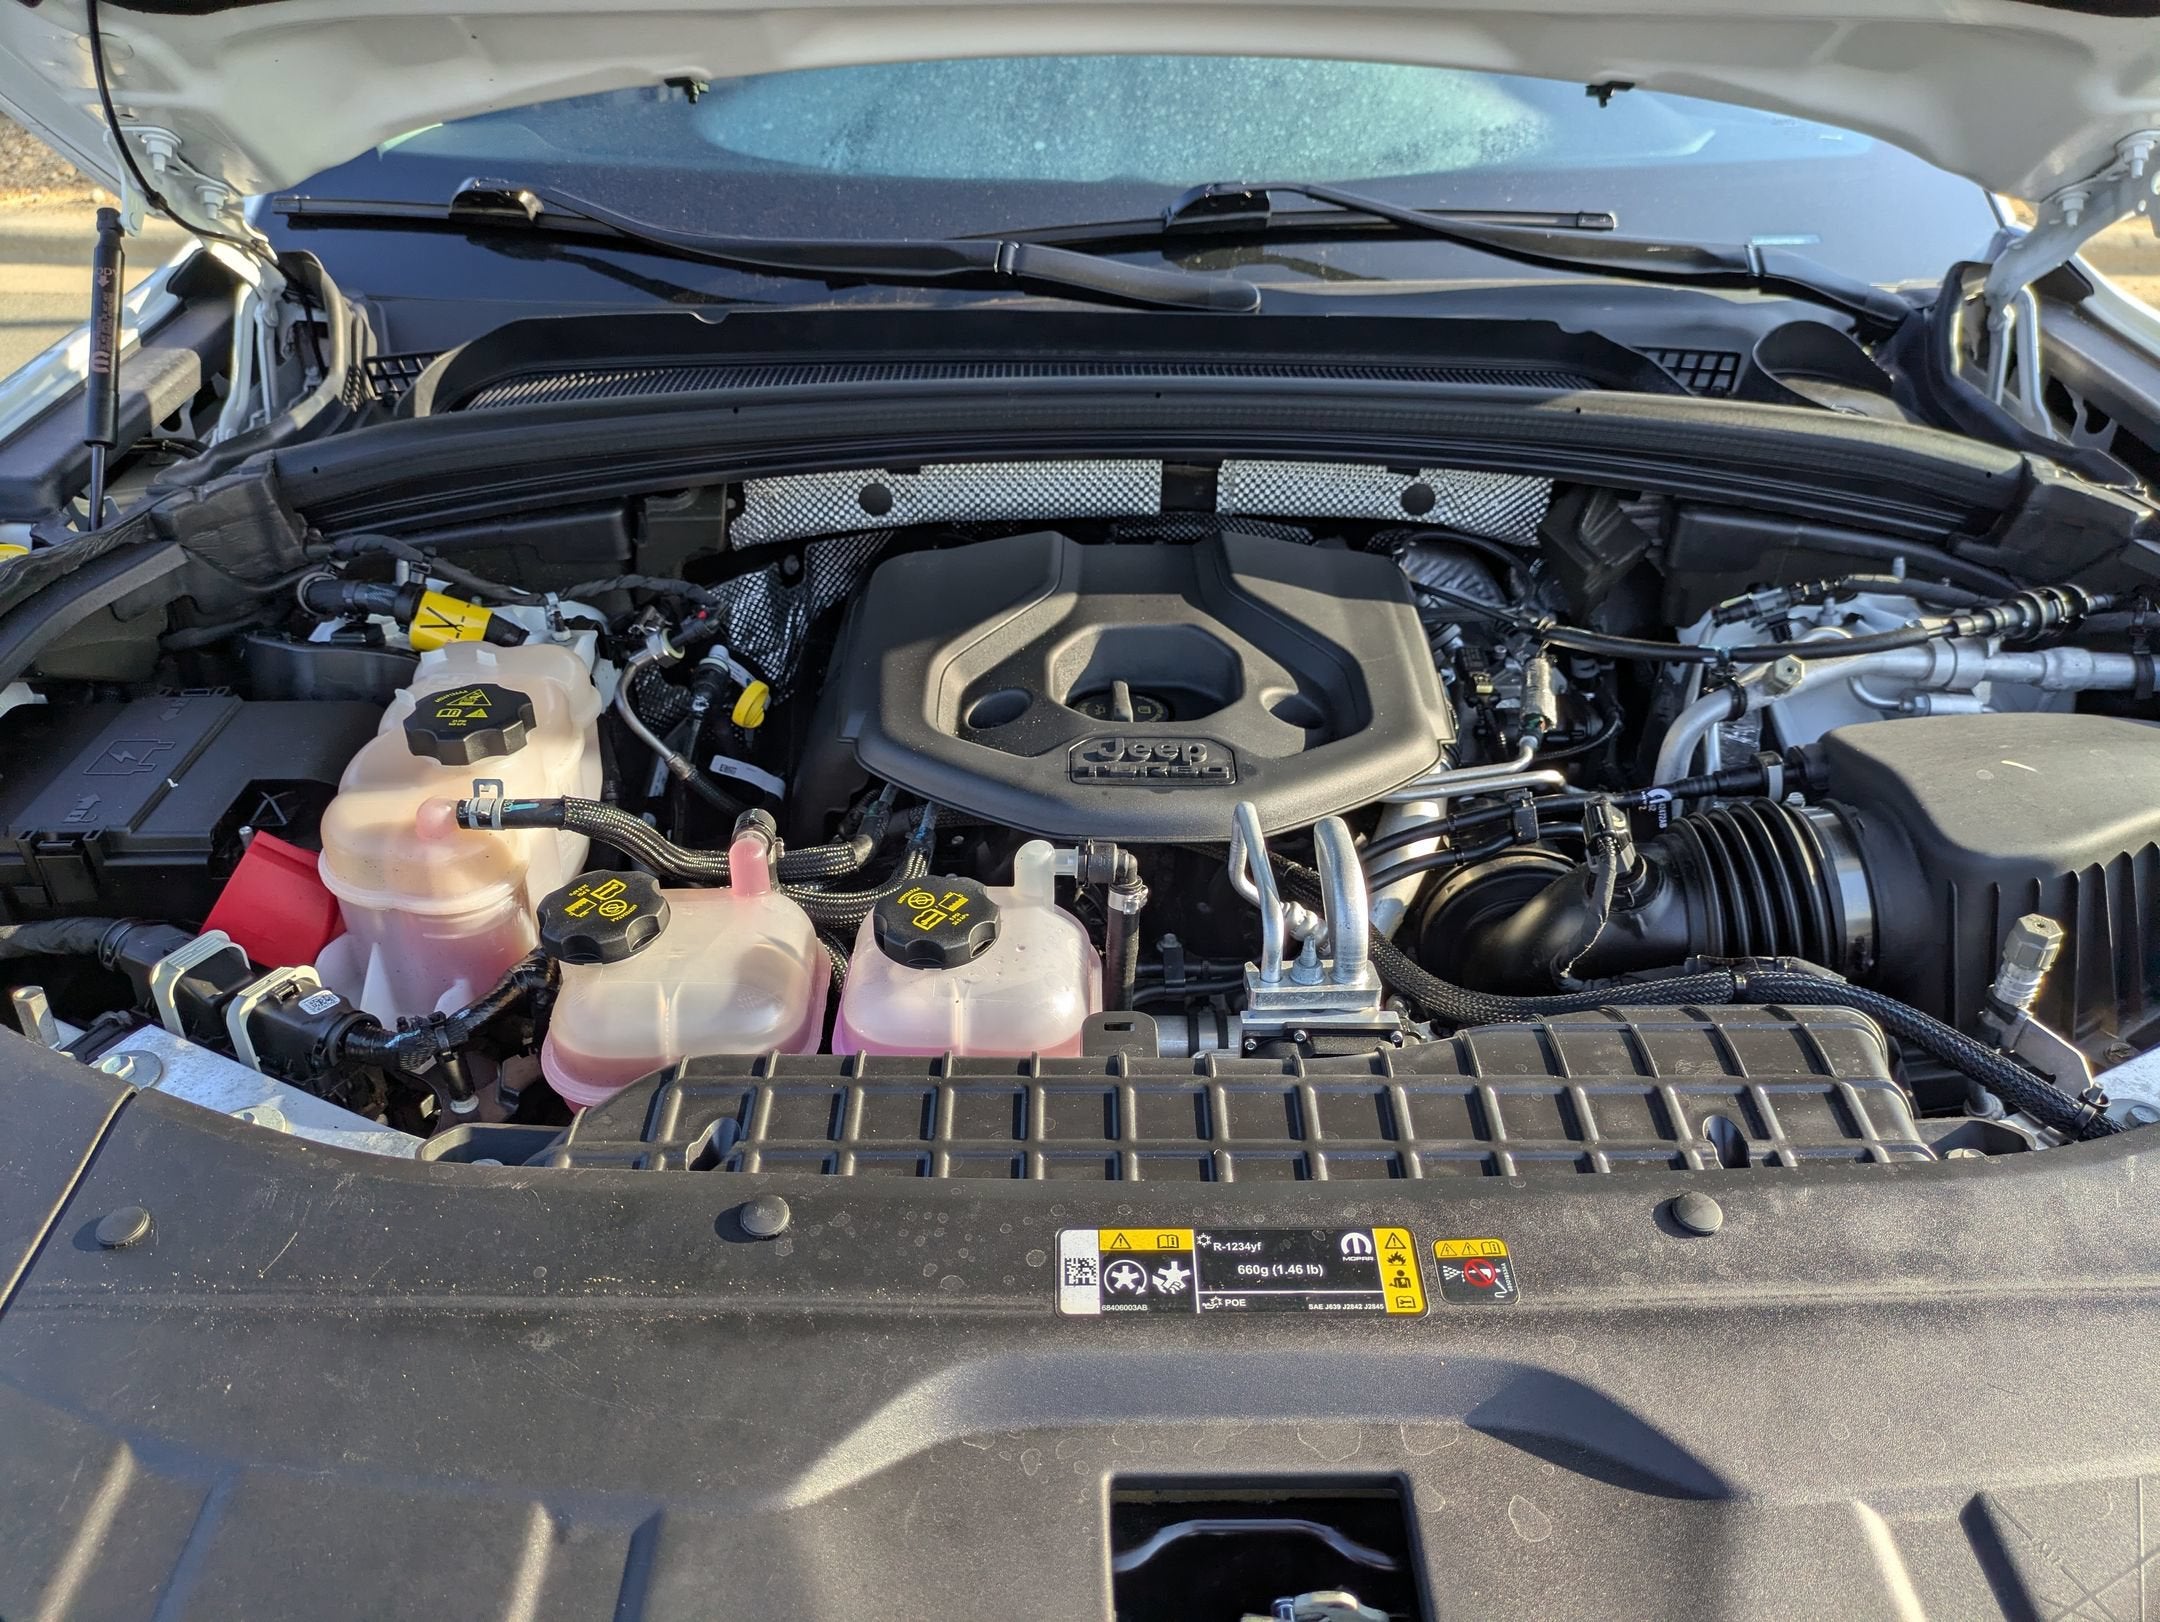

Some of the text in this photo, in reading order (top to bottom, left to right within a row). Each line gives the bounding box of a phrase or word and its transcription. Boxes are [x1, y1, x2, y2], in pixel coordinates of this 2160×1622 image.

[1097, 737, 1208, 766] Jeep
[1213, 1242, 1262, 1253] R-1234yf
[1237, 1264, 1323, 1277] 660g (1.46 lb)
[1224, 1298, 1247, 1307] POE
